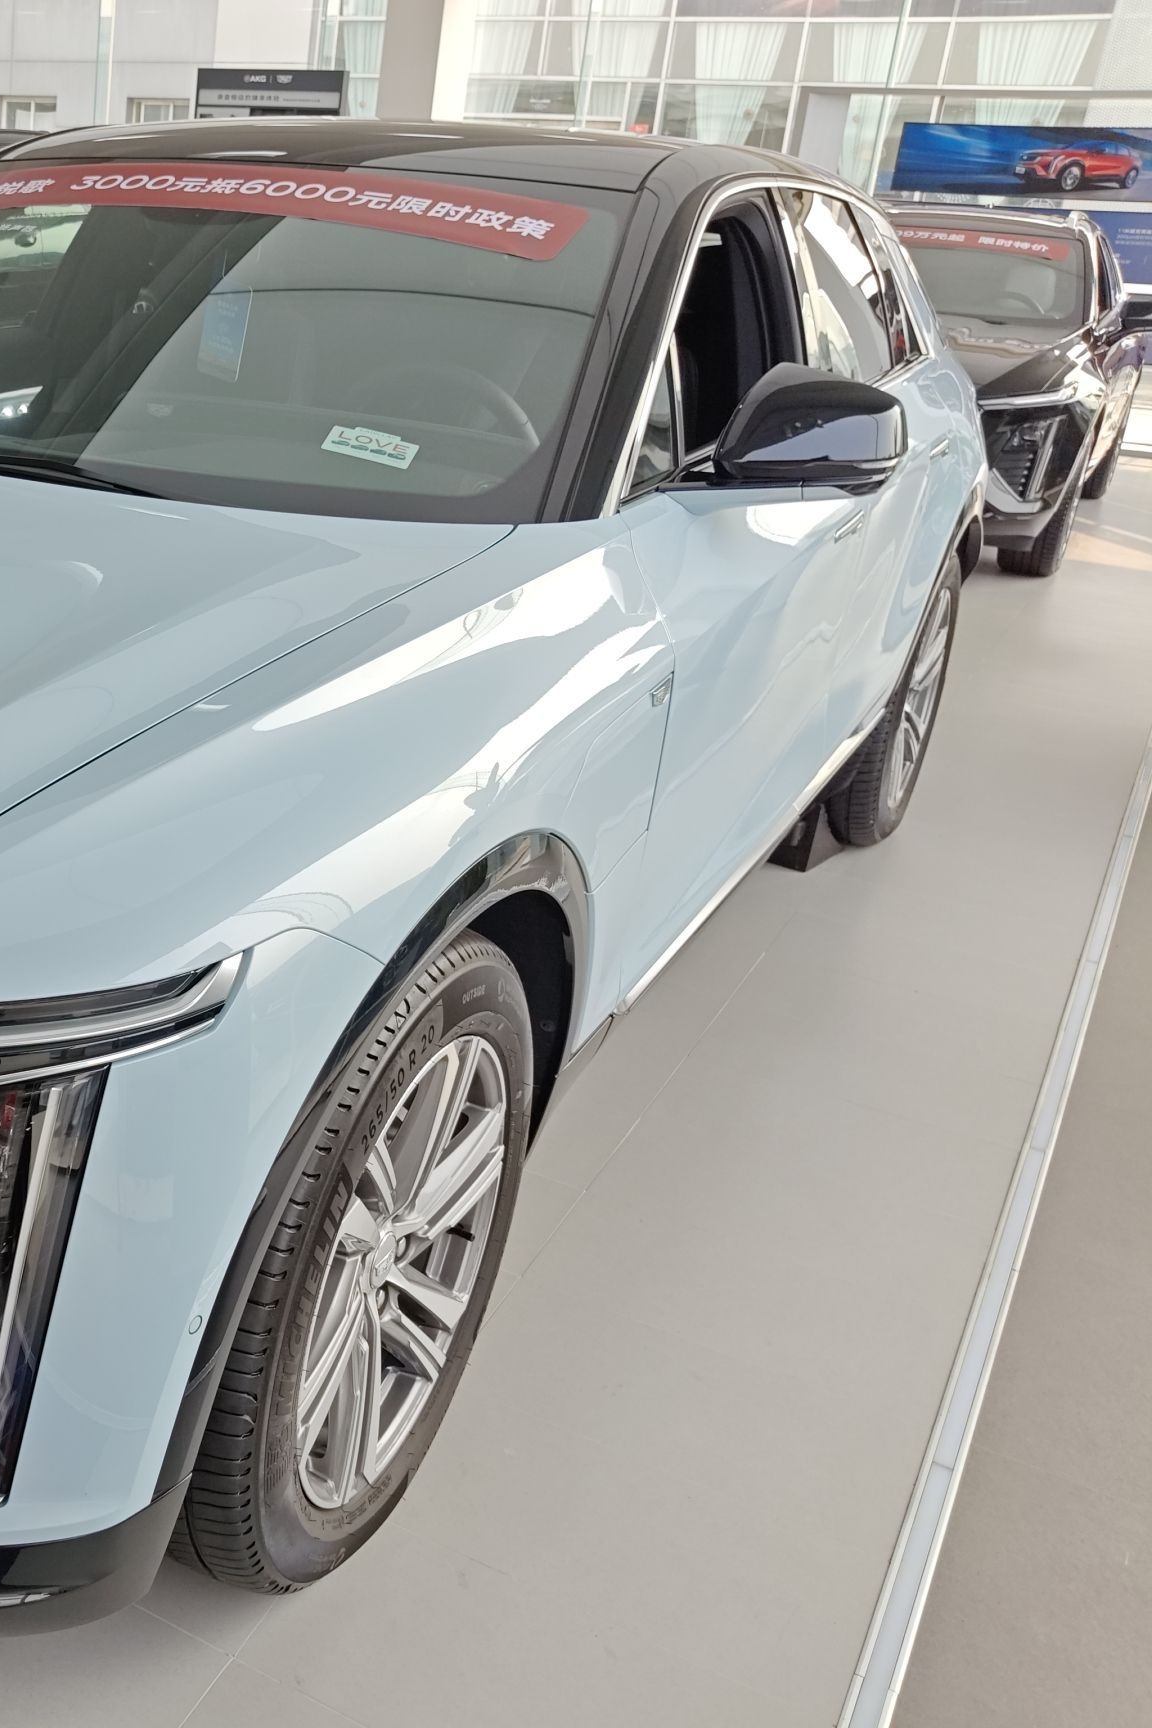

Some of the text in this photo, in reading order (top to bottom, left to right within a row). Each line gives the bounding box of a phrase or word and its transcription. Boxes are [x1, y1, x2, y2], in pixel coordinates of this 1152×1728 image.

[70, 174, 555, 241] 3000元抵6000元限时政策
[977, 235, 1049, 252] 限时特价
[337, 430, 410, 455] LOVE
[462, 984, 486, 1005] OUTSIDE
[361, 1024, 436, 1154] 265/50 R 20
[275, 1180, 349, 1419] MICHELIN
